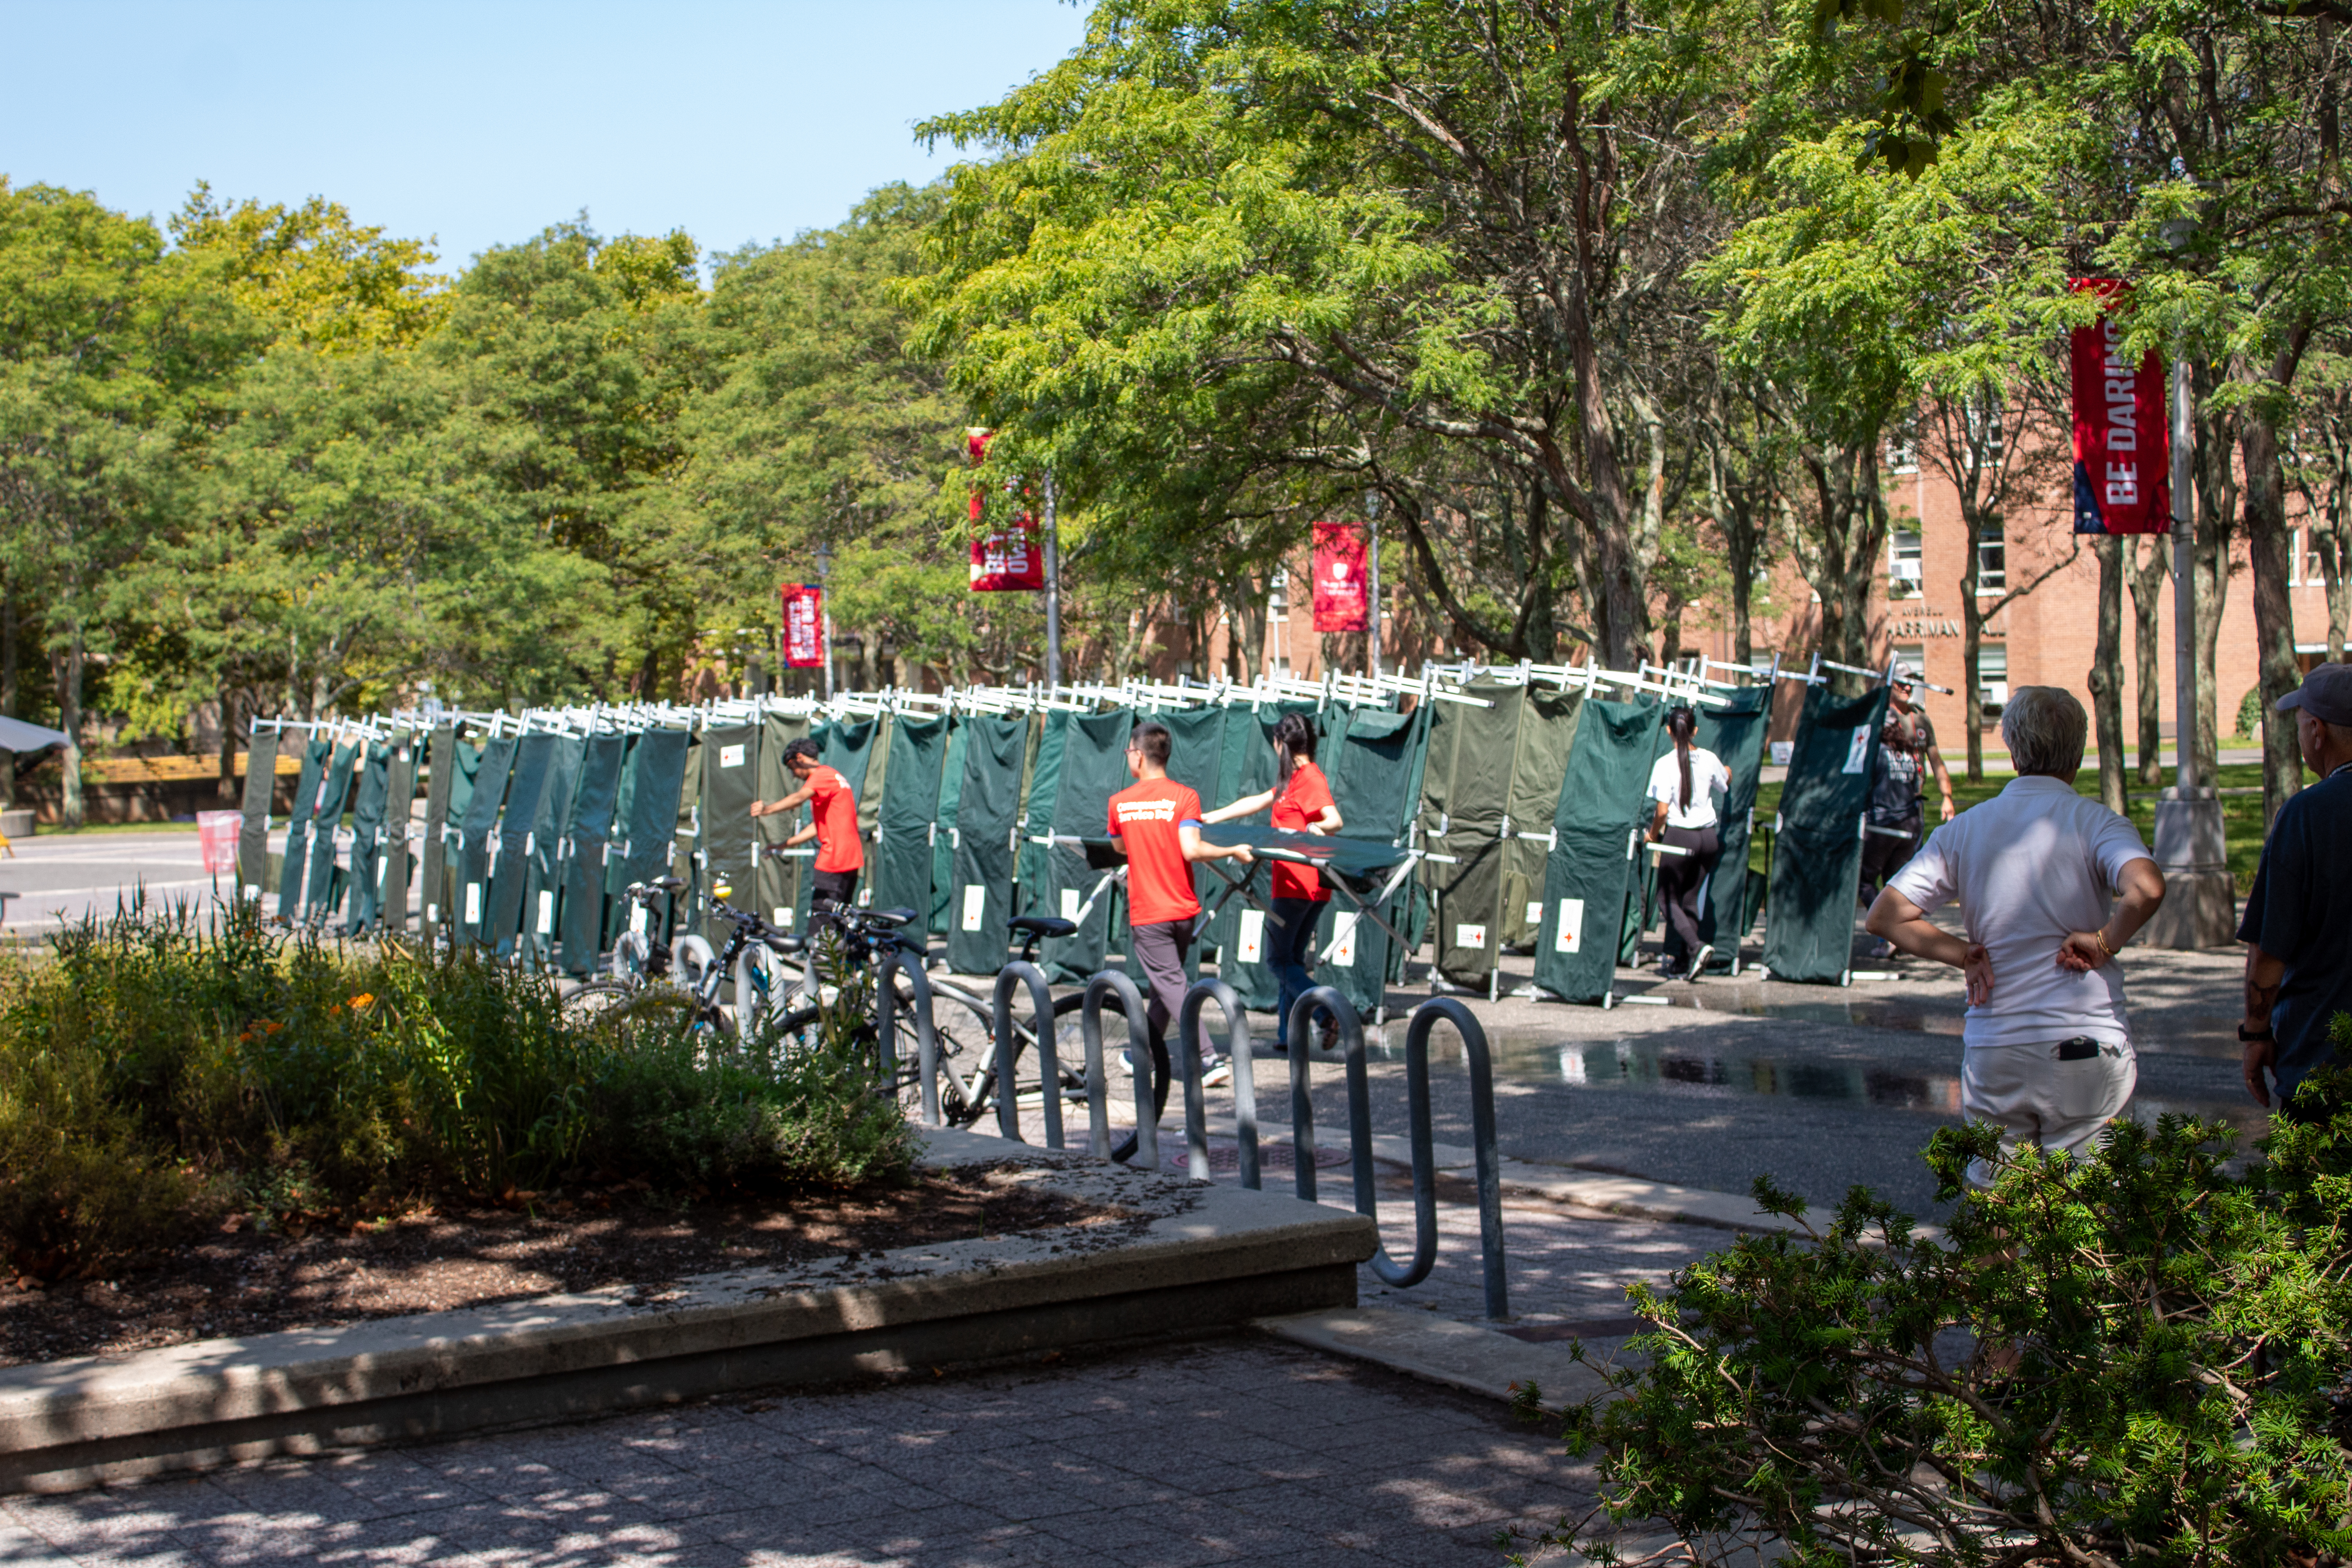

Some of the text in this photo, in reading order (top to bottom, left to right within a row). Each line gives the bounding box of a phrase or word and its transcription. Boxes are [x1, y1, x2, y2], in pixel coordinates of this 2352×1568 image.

[2106, 462, 2138, 505] BE
[984, 548, 1005, 574] BE
[1903, 606, 1944, 617] AVERELL
[1886, 619, 2006, 638] HARRIMAN ALL
[1117, 799, 1176, 813] Community
[1118, 809, 1175, 823] Service Day
